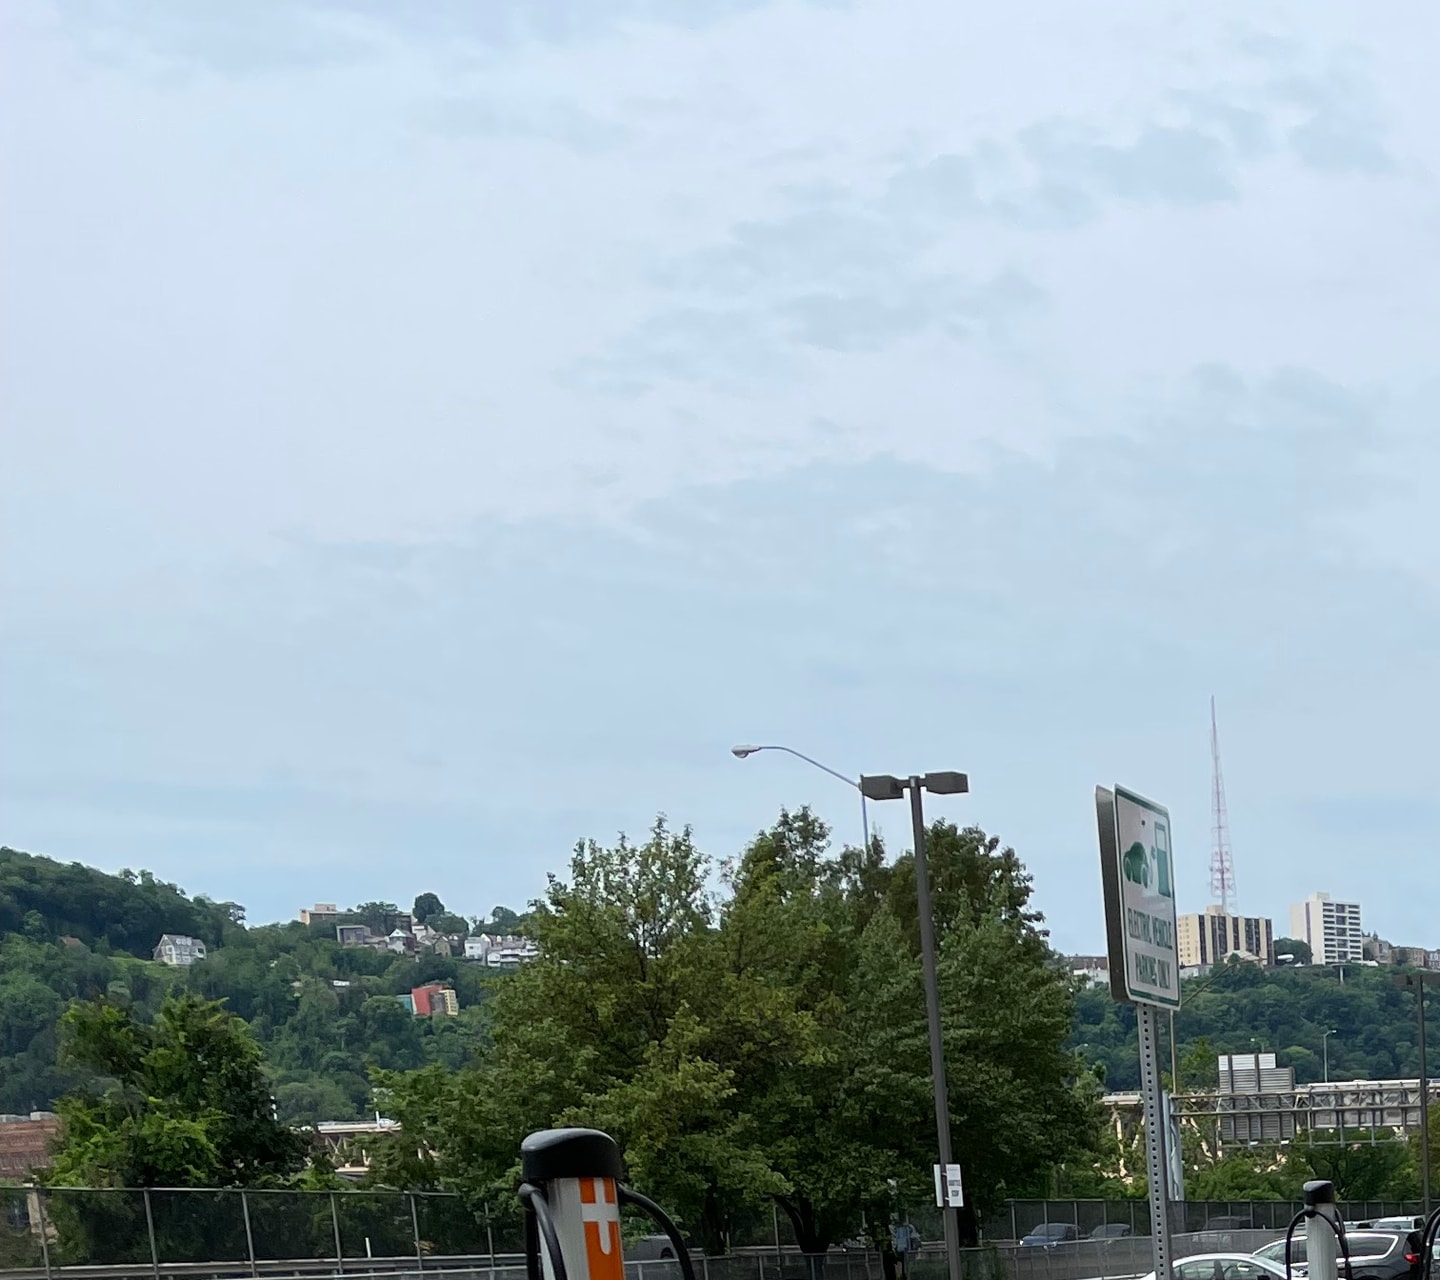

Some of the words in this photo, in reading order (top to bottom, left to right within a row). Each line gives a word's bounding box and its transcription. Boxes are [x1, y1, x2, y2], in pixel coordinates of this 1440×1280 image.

[1128, 907, 1152, 944] ELECTRIC
[1152, 916, 1173, 950] VEHICLE
[1135, 952, 1157, 986] PARKING
[1158, 959, 1171, 989] ONLY
